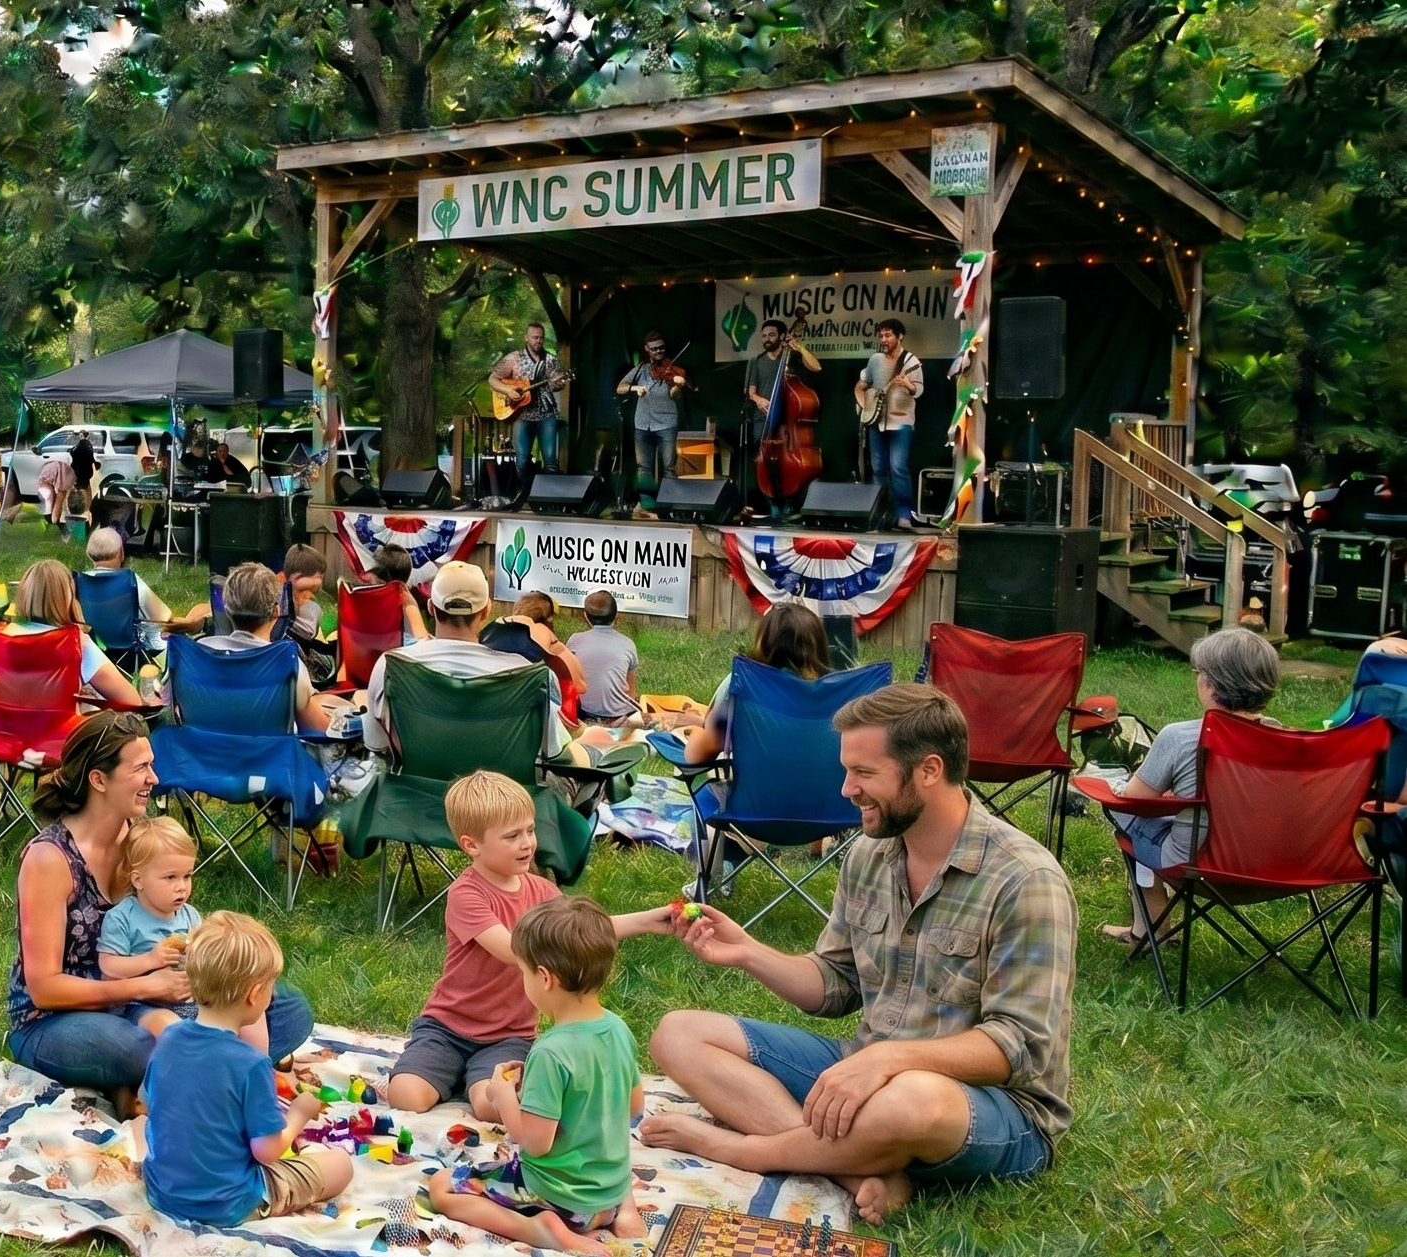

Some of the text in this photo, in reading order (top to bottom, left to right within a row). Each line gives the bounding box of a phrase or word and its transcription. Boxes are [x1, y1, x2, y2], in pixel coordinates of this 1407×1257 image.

[472, 152, 796, 228] WNC SUMMER
[761, 284, 949, 321] MUSIC ON MAIN
[536, 534, 688, 568] MUSIC ON MAIN
